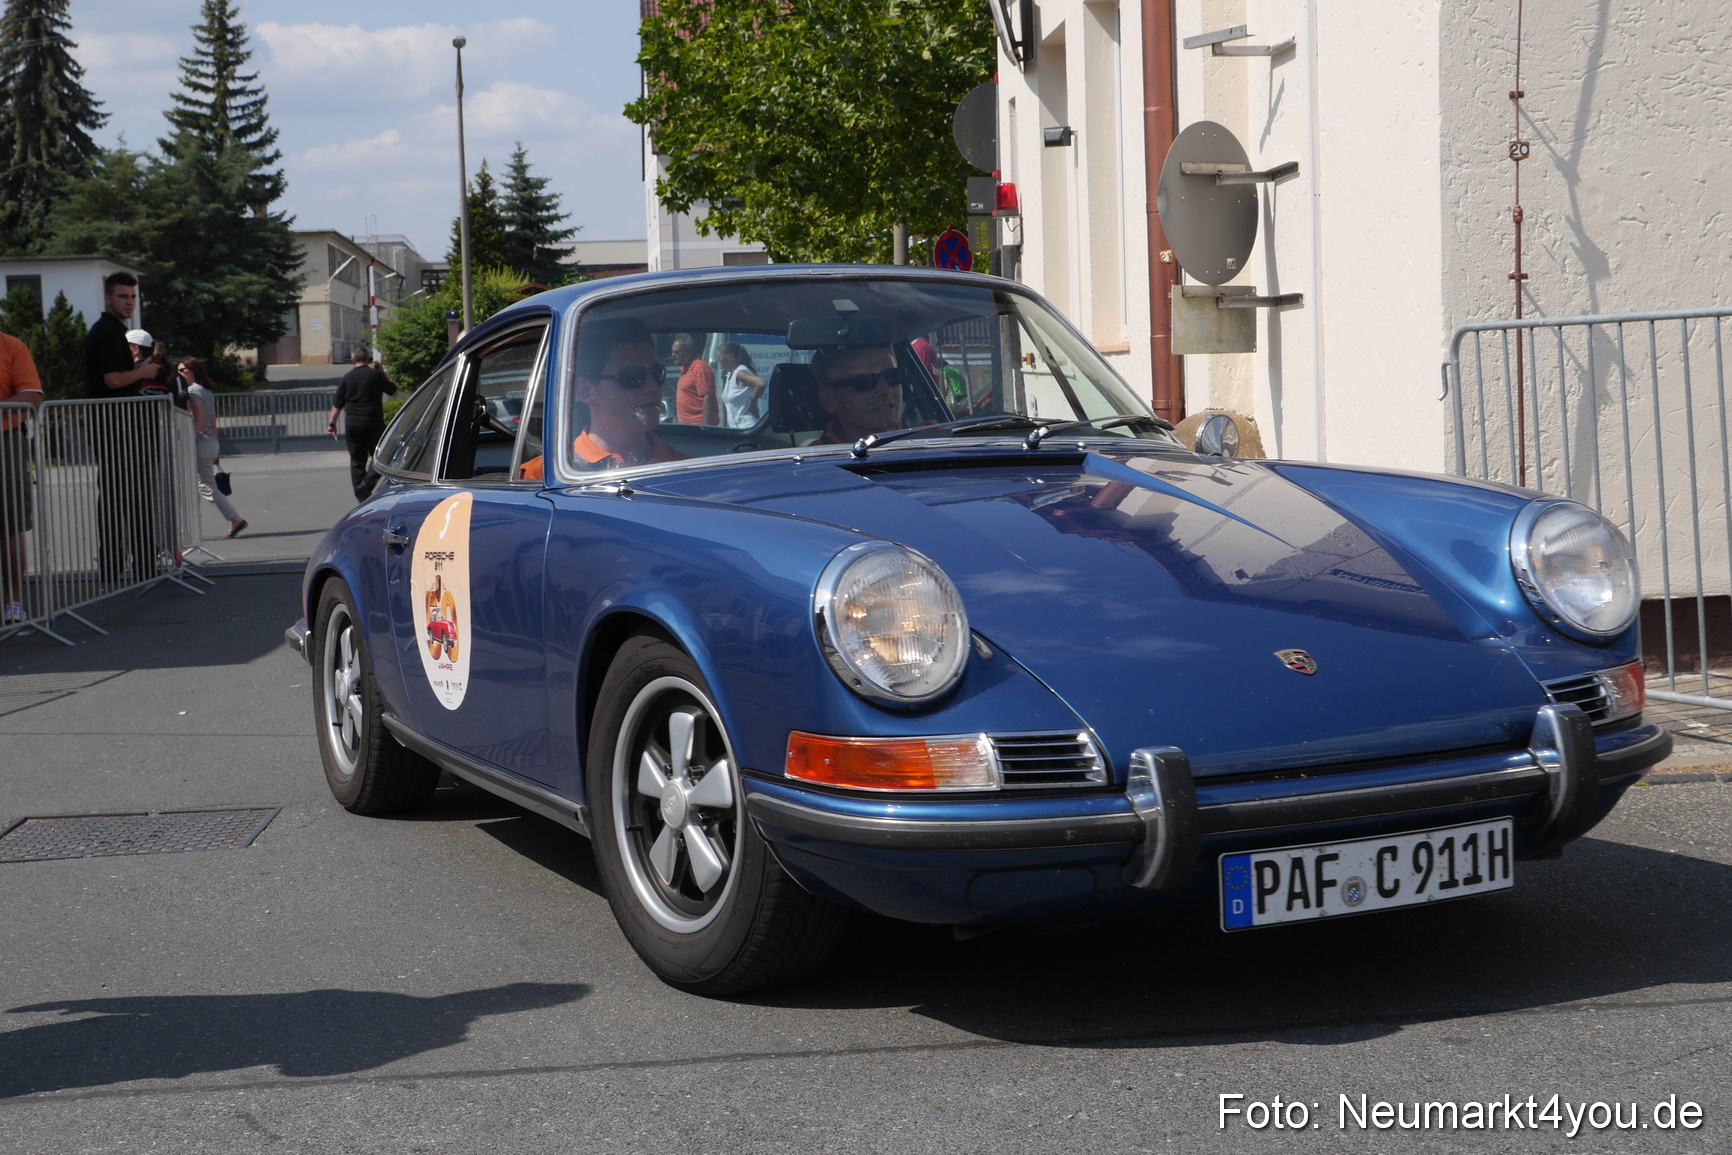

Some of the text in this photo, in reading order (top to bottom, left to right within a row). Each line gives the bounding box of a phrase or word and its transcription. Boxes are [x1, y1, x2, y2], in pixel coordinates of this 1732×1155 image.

[1510, 144, 1529, 155] 20
[425, 551, 455, 560] PORSCHE
[1255, 827, 1510, 915] PAF C 911H
[1232, 899, 1244, 914] D
